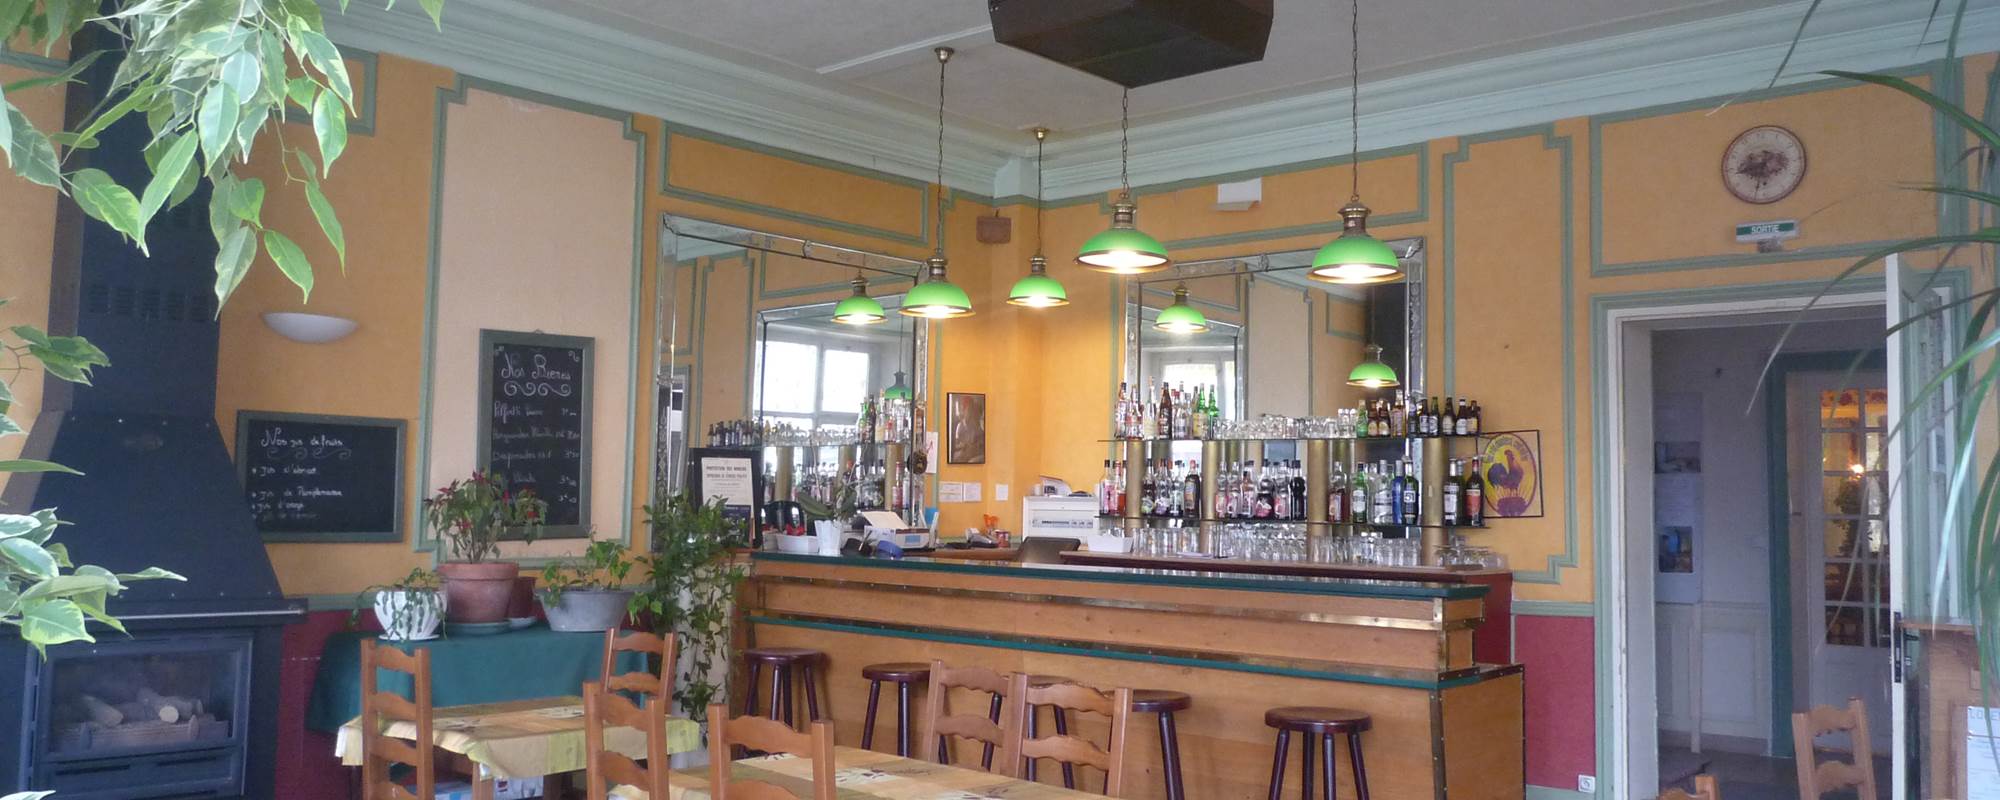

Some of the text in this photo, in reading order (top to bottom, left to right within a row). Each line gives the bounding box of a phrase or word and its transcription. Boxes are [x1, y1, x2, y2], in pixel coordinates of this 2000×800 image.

[1751, 224, 1780, 233] SORTIE
[501, 352, 525, 379] Nos
[261, 427, 288, 447] Nos
